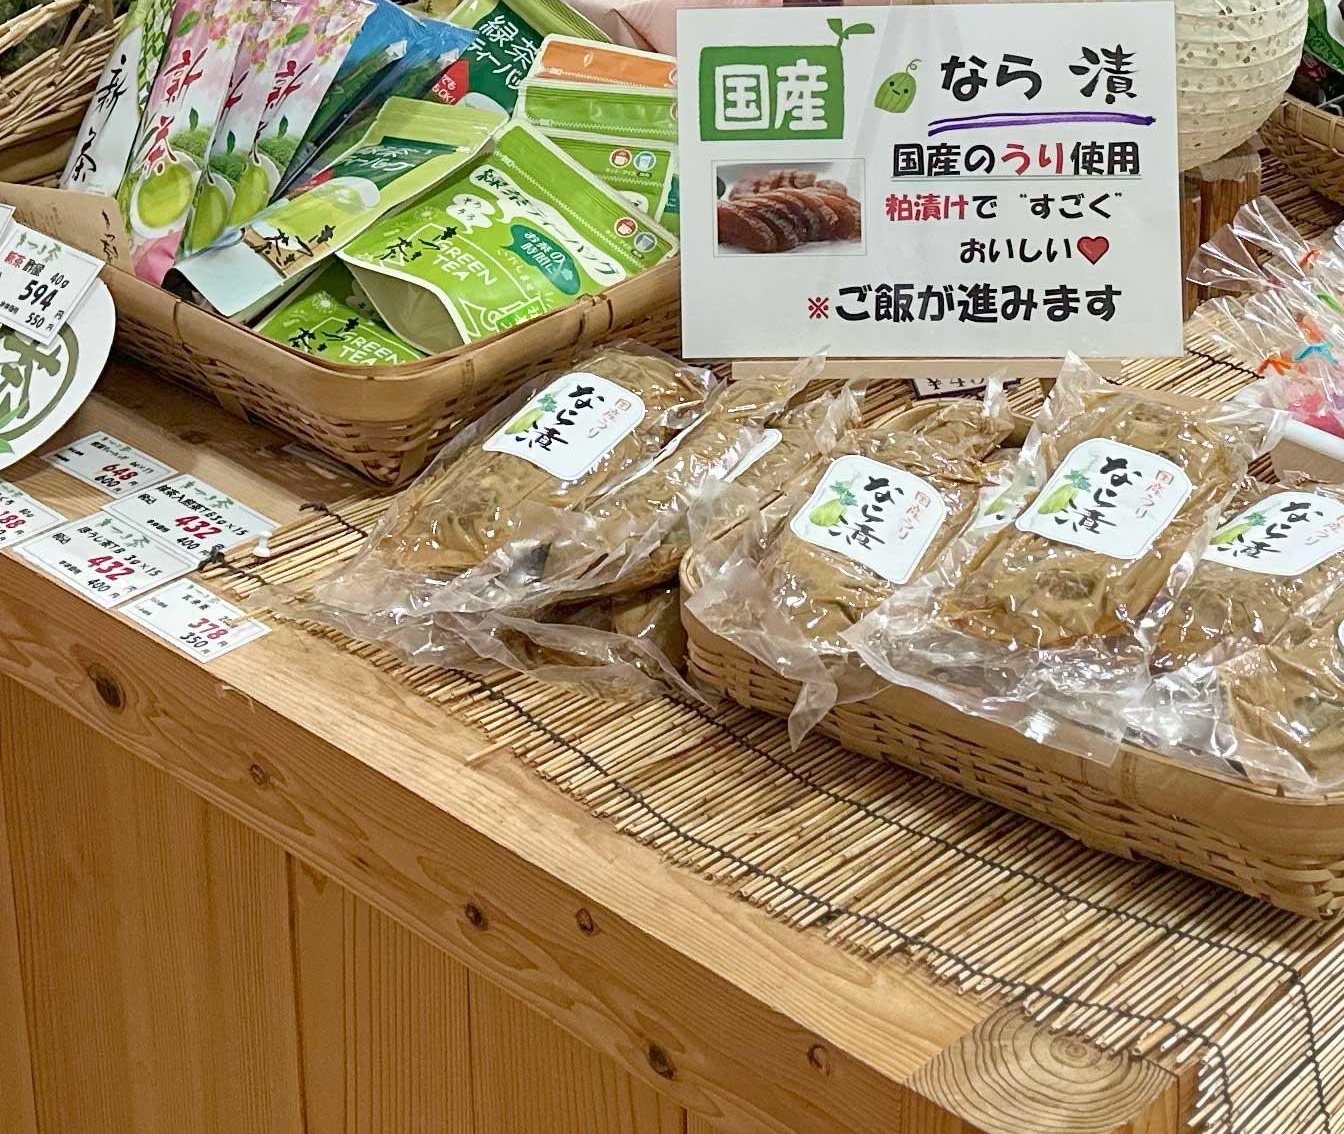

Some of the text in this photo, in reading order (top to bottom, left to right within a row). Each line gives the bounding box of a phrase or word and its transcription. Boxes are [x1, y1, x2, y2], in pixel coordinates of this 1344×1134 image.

[713, 58, 830, 133] 国産
[892, 141, 1141, 177] 国産のうり使用
[885, 193, 999, 222] 粕漬けで
[438, 239, 498, 286] GREEN
[959, 236, 1073, 265] おいしい
[434, 254, 472, 281] TEA
[17, 278, 59, 312] 594
[24, 312, 46, 329] 550
[93, 474, 121, 489] 600
[102, 463, 139, 482] 648
[1053, 454, 1144, 536] なら漬
[173, 514, 223, 541] 432
[826, 474, 911, 554] なら漬
[175, 535, 201, 551] 400
[86, 554, 136, 582] 432
[86, 577, 113, 593] 400
[178, 630, 210, 649] 350
[187, 617, 230, 641] 378
